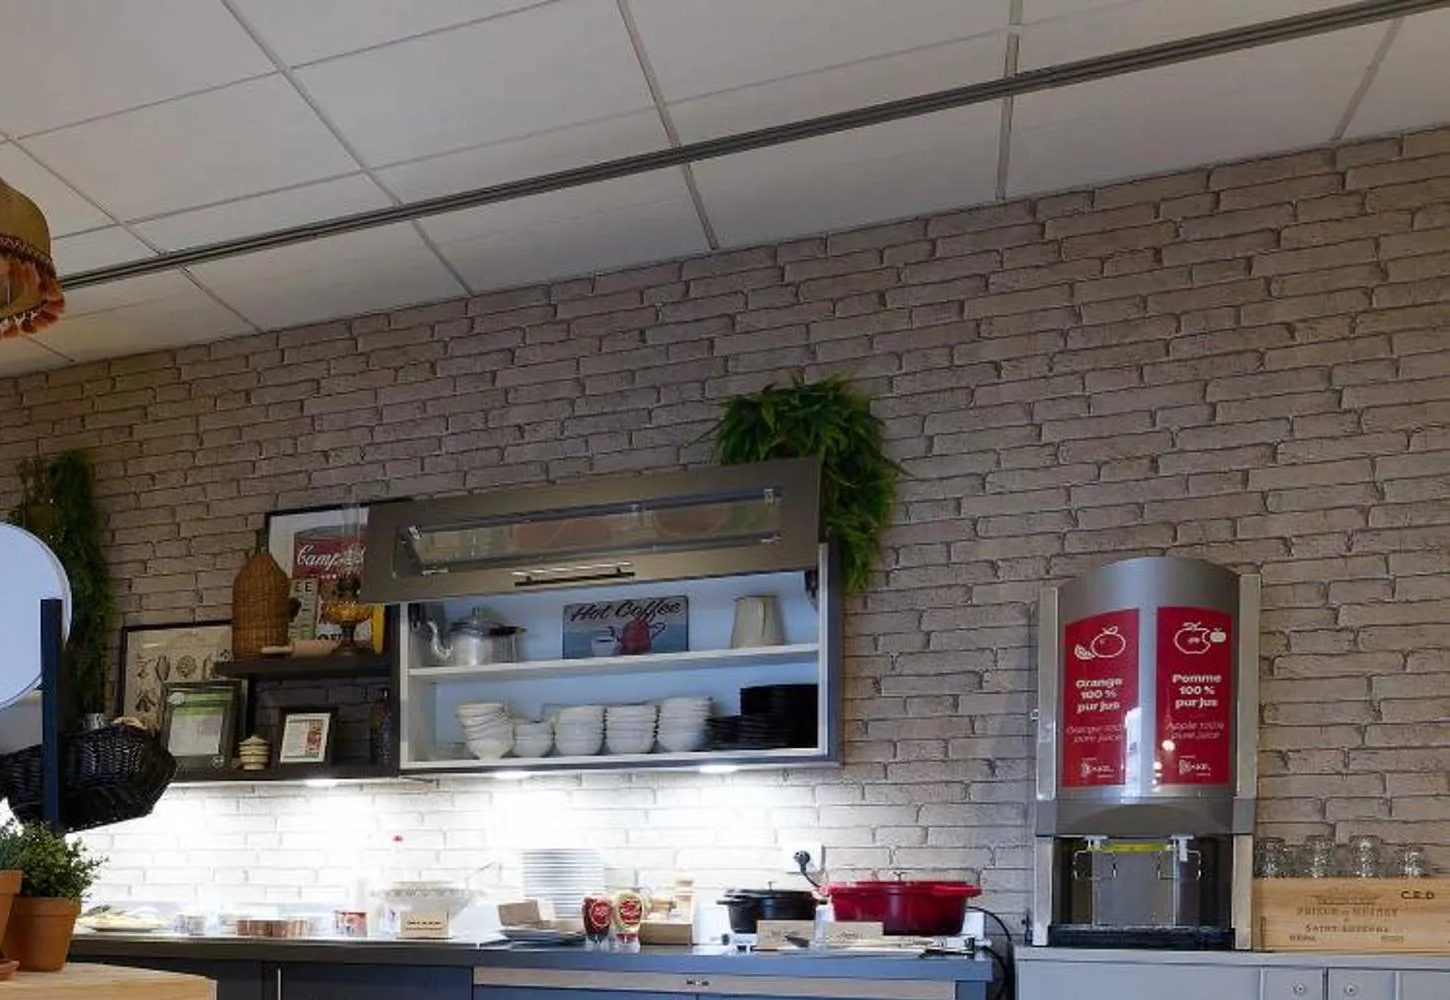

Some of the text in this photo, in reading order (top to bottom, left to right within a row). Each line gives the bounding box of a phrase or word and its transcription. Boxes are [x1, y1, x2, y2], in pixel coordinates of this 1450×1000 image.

[571, 599, 681, 621] Hot Coffee
[1075, 678, 1123, 689] Orange
[1172, 674, 1222, 683] Pomme
[1080, 690, 1103, 699] 100
[1179, 686, 1201, 695] 100
[1076, 700, 1120, 714] pur jus
[1175, 697, 1218, 709] pur jus
